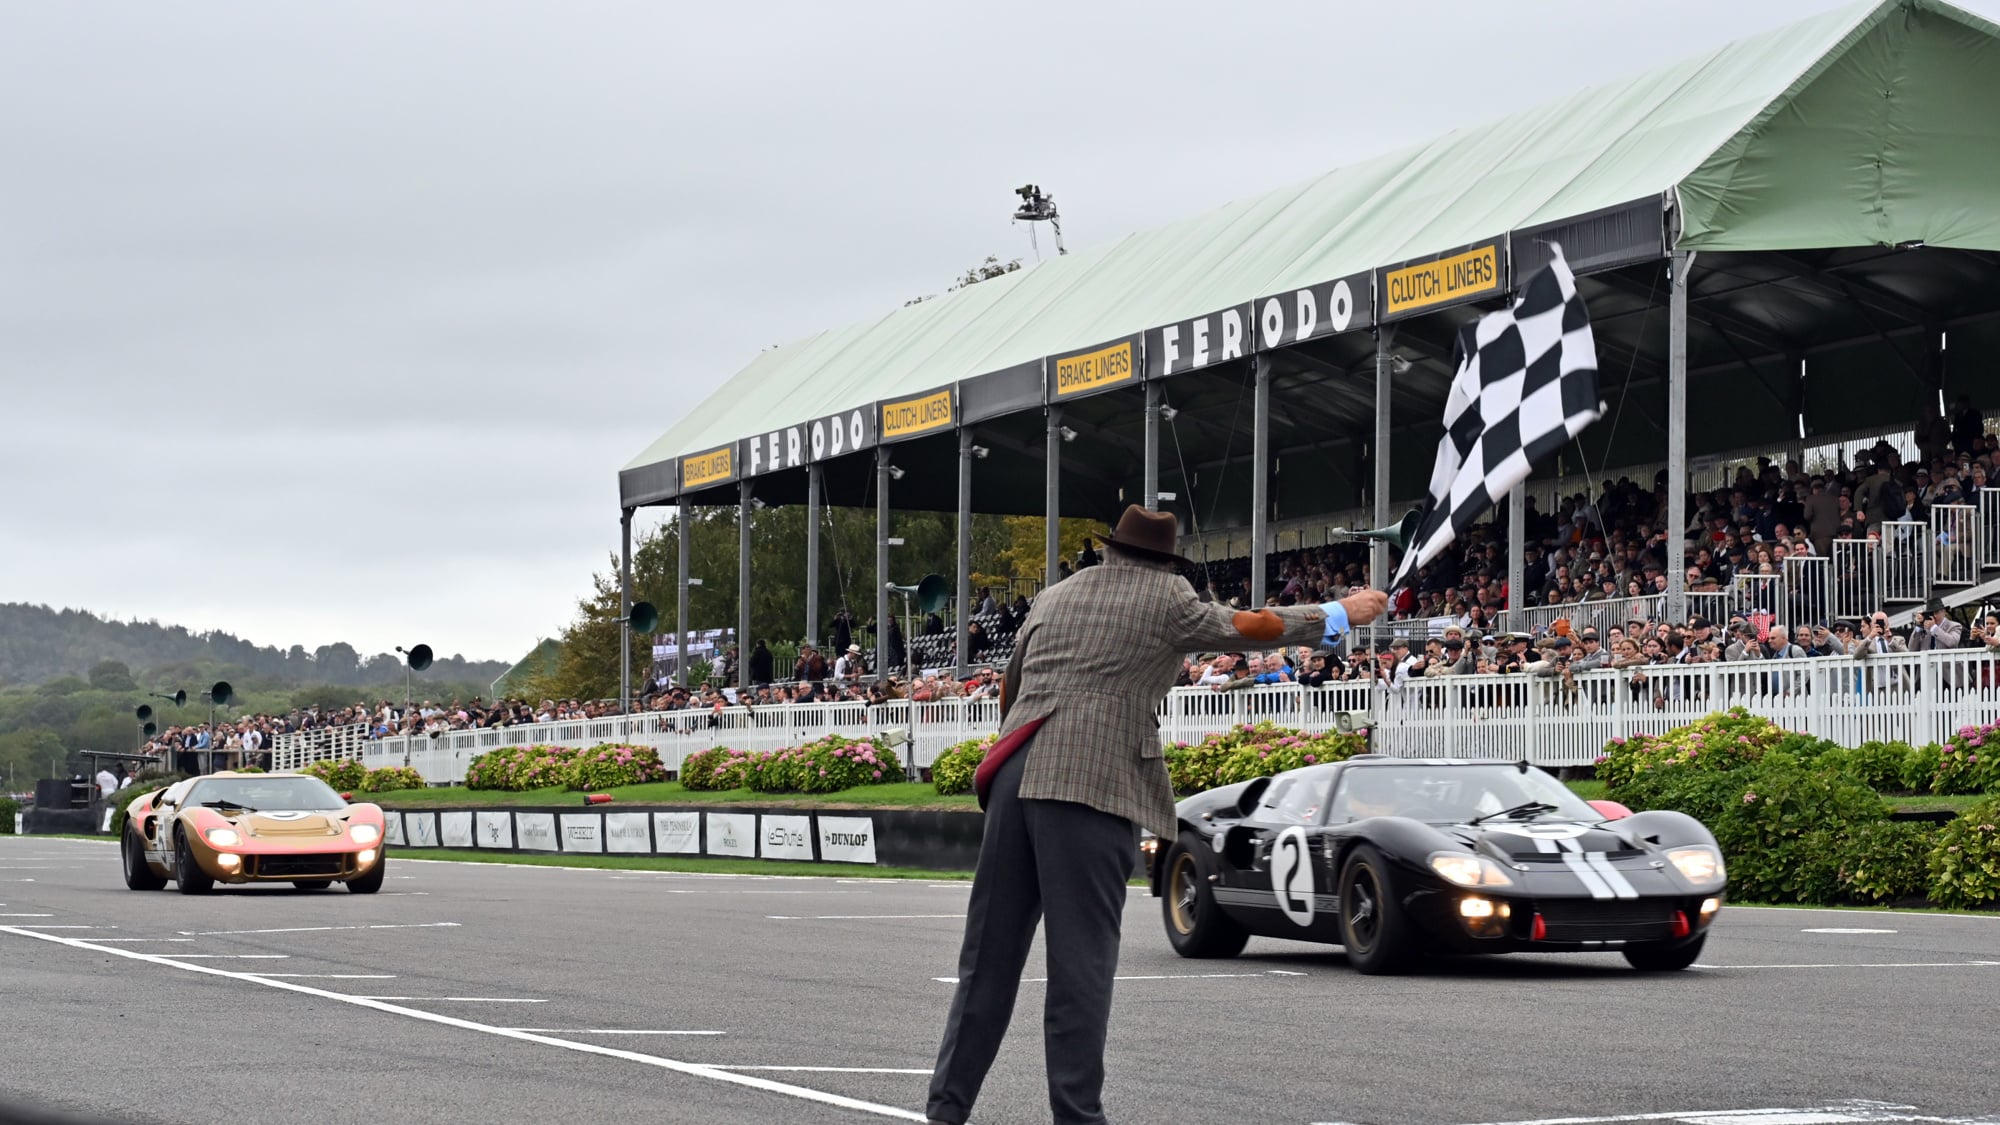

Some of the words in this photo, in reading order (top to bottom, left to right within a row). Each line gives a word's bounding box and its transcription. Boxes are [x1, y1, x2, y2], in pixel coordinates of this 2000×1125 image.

[1391, 268, 1441, 305] CLUTCH
[1446, 254, 1492, 291] LINERS
[1162, 279, 1353, 376] FERODO
[1060, 360, 1092, 387] BRAKE
[1095, 349, 1129, 379] LINERS
[885, 406, 917, 430] CLUTCH
[920, 397, 948, 424] LINERS
[750, 409, 864, 476] FERODO
[685, 460, 706, 482] BRAKE
[708, 453, 729, 476] LINERS
[831, 832, 868, 847] DUNLOP
[1282, 833, 1309, 913] 2
